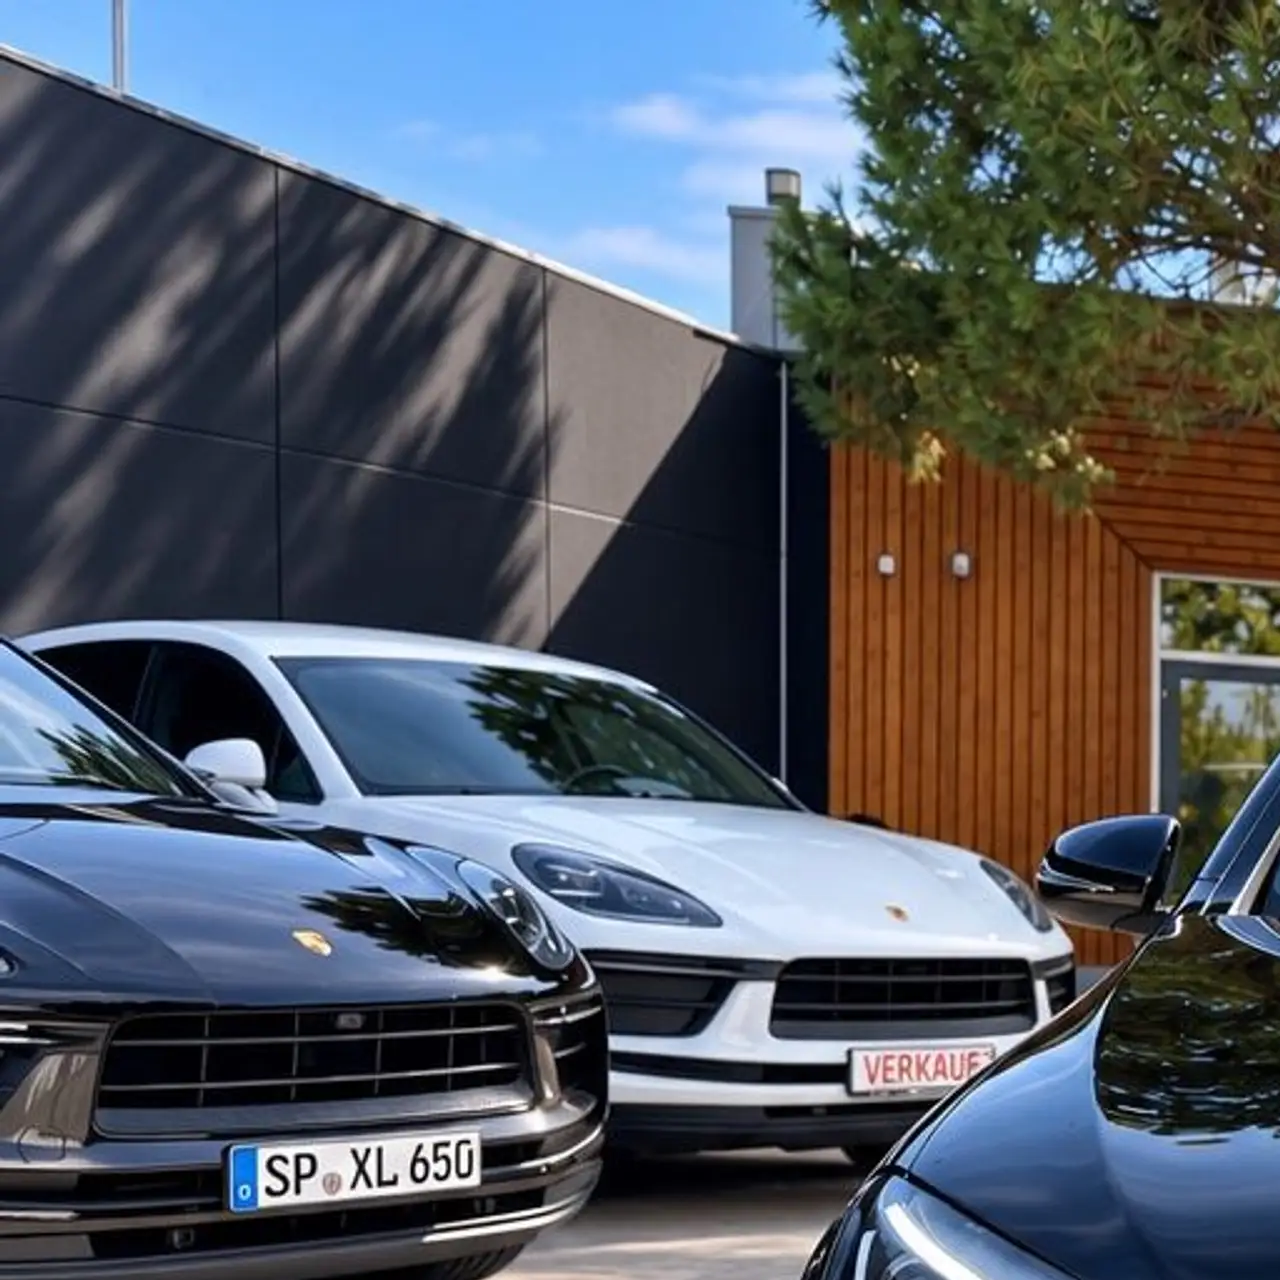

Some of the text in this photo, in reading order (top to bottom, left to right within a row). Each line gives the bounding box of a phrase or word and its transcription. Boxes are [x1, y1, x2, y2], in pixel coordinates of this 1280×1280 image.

[864, 1052, 989, 1084] VERKAUF
[265, 1139, 474, 1197] SP XL 650
